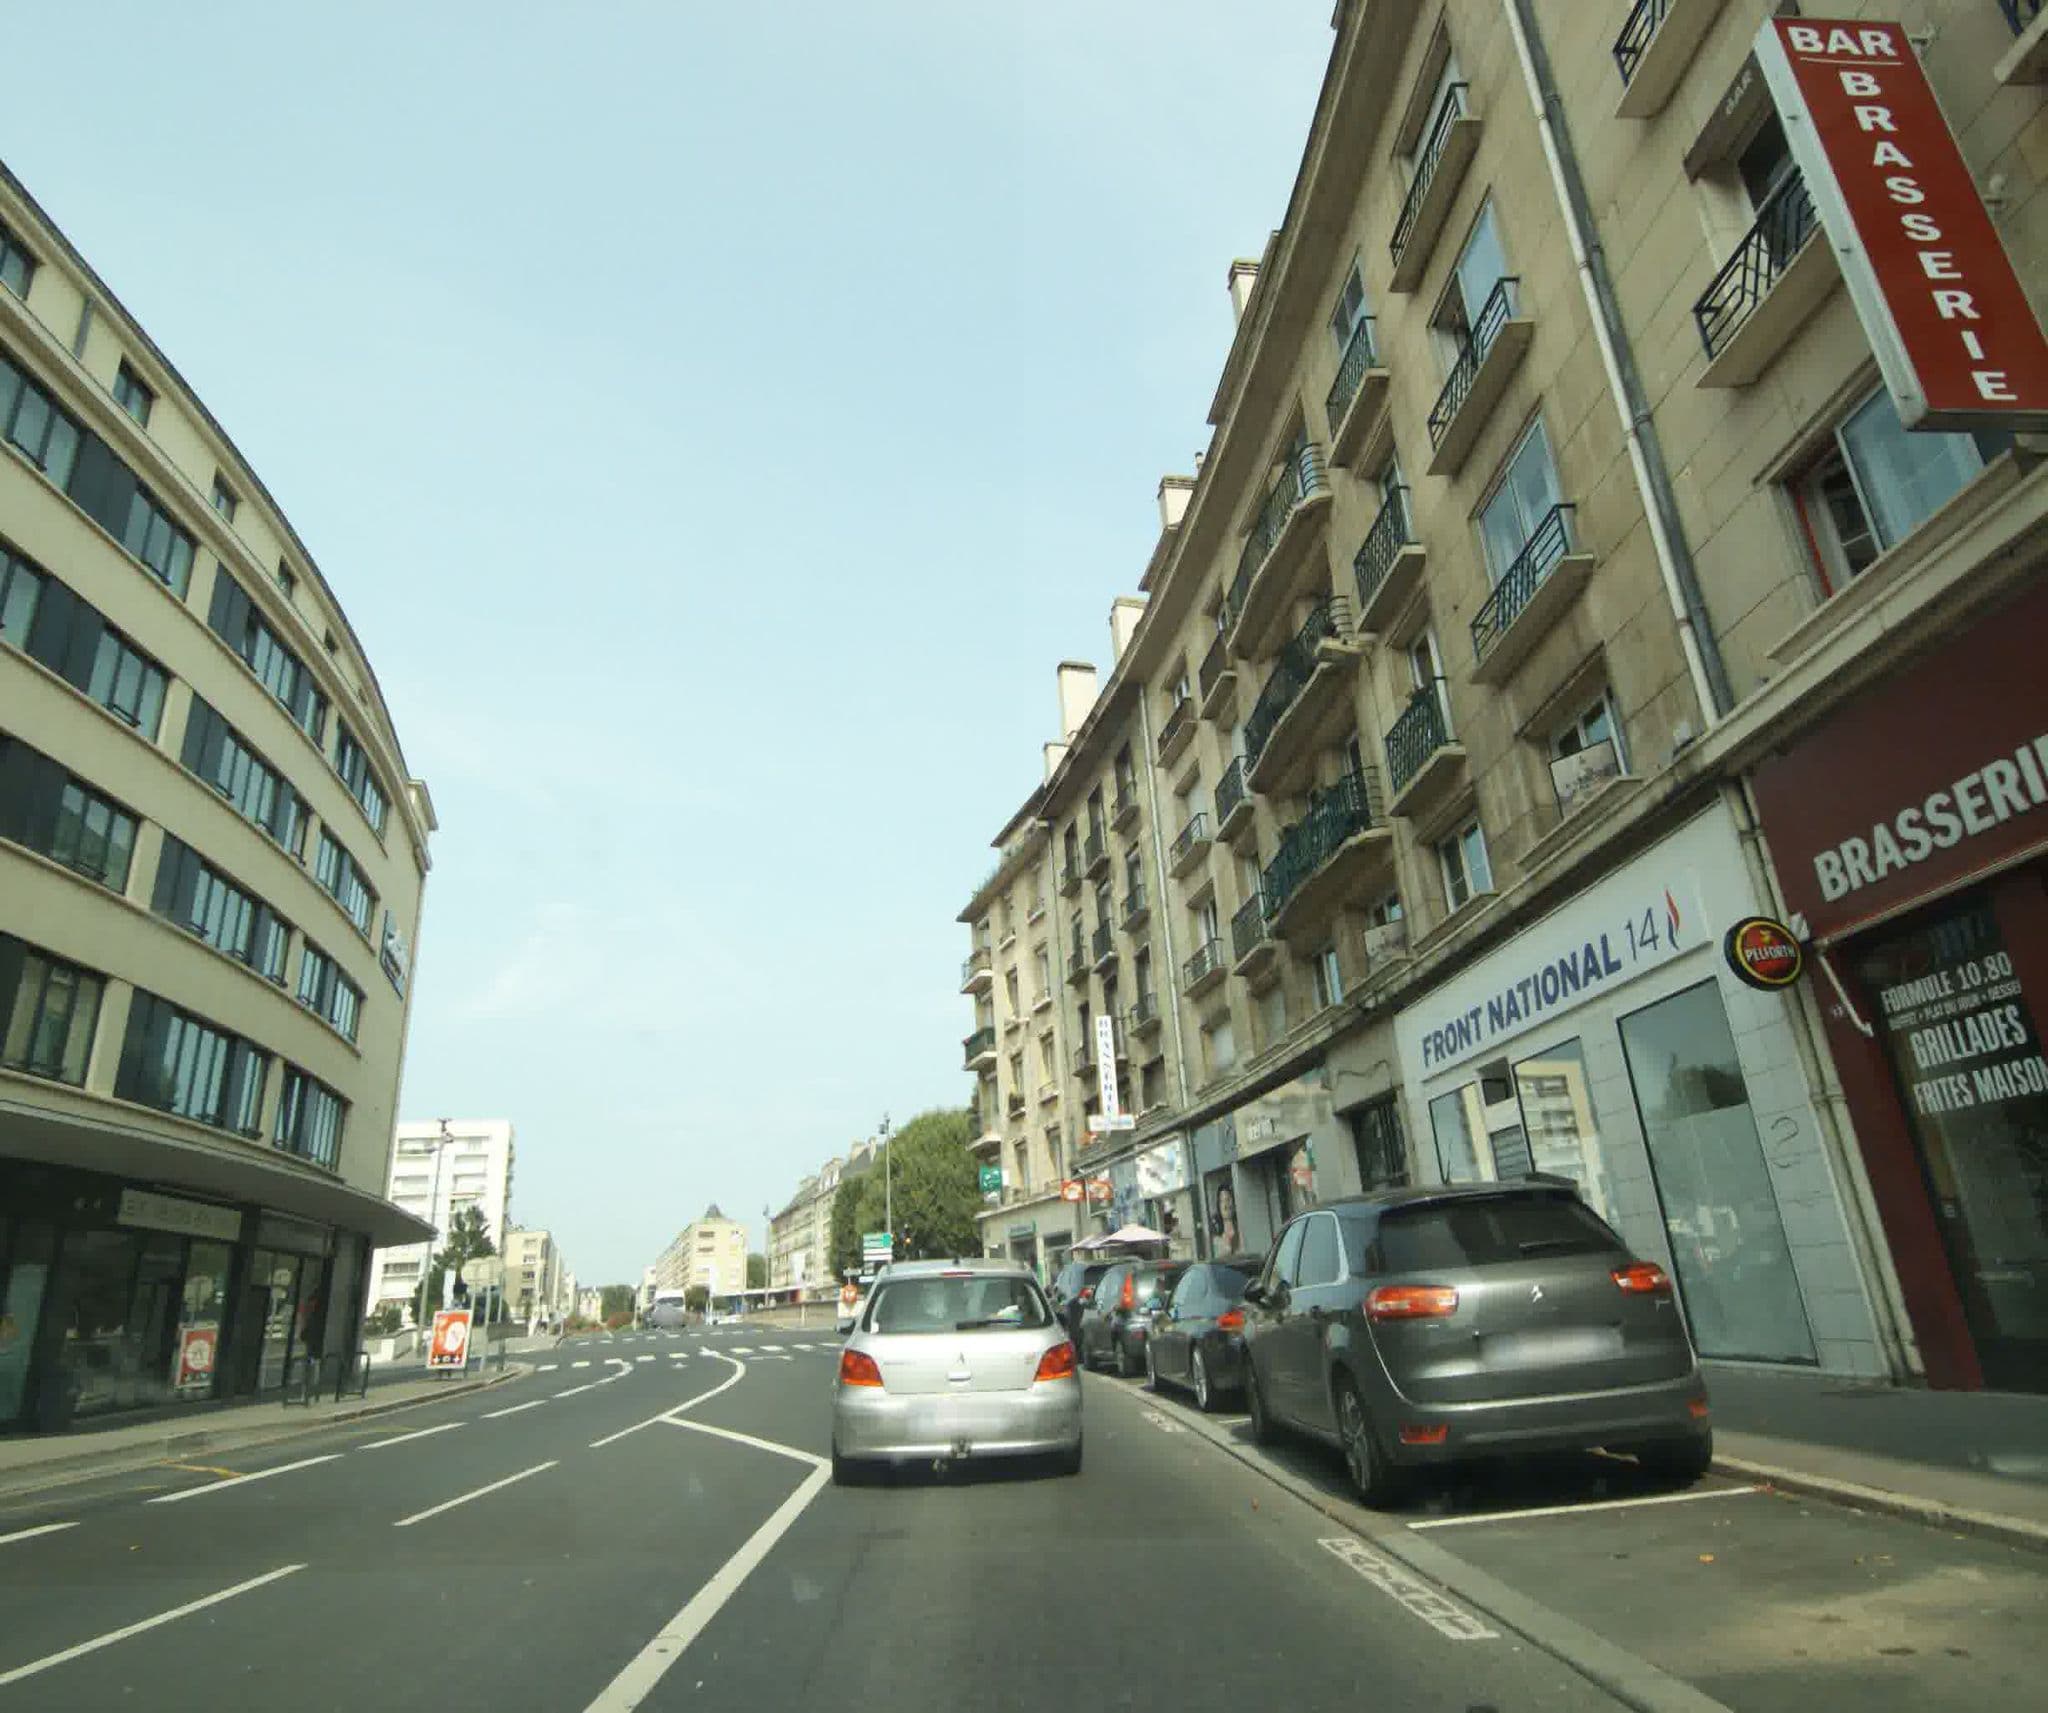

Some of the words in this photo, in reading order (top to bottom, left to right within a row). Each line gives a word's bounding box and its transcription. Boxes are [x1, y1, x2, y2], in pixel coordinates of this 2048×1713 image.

[1787, 26, 1898, 57] BAR
[1839, 71, 2018, 402] BRASSERIE
[1421, 1007, 1483, 1068] FRONT
[1488, 933, 1622, 1033] NATIONAL
[1625, 906, 1660, 961] 14
[1880, 971, 1955, 1014] FORMULE
[1956, 951, 2013, 991] 10.80
[1909, 1004, 2028, 1070] GRILLADES
[1912, 1073, 1974, 1115] FRITES
